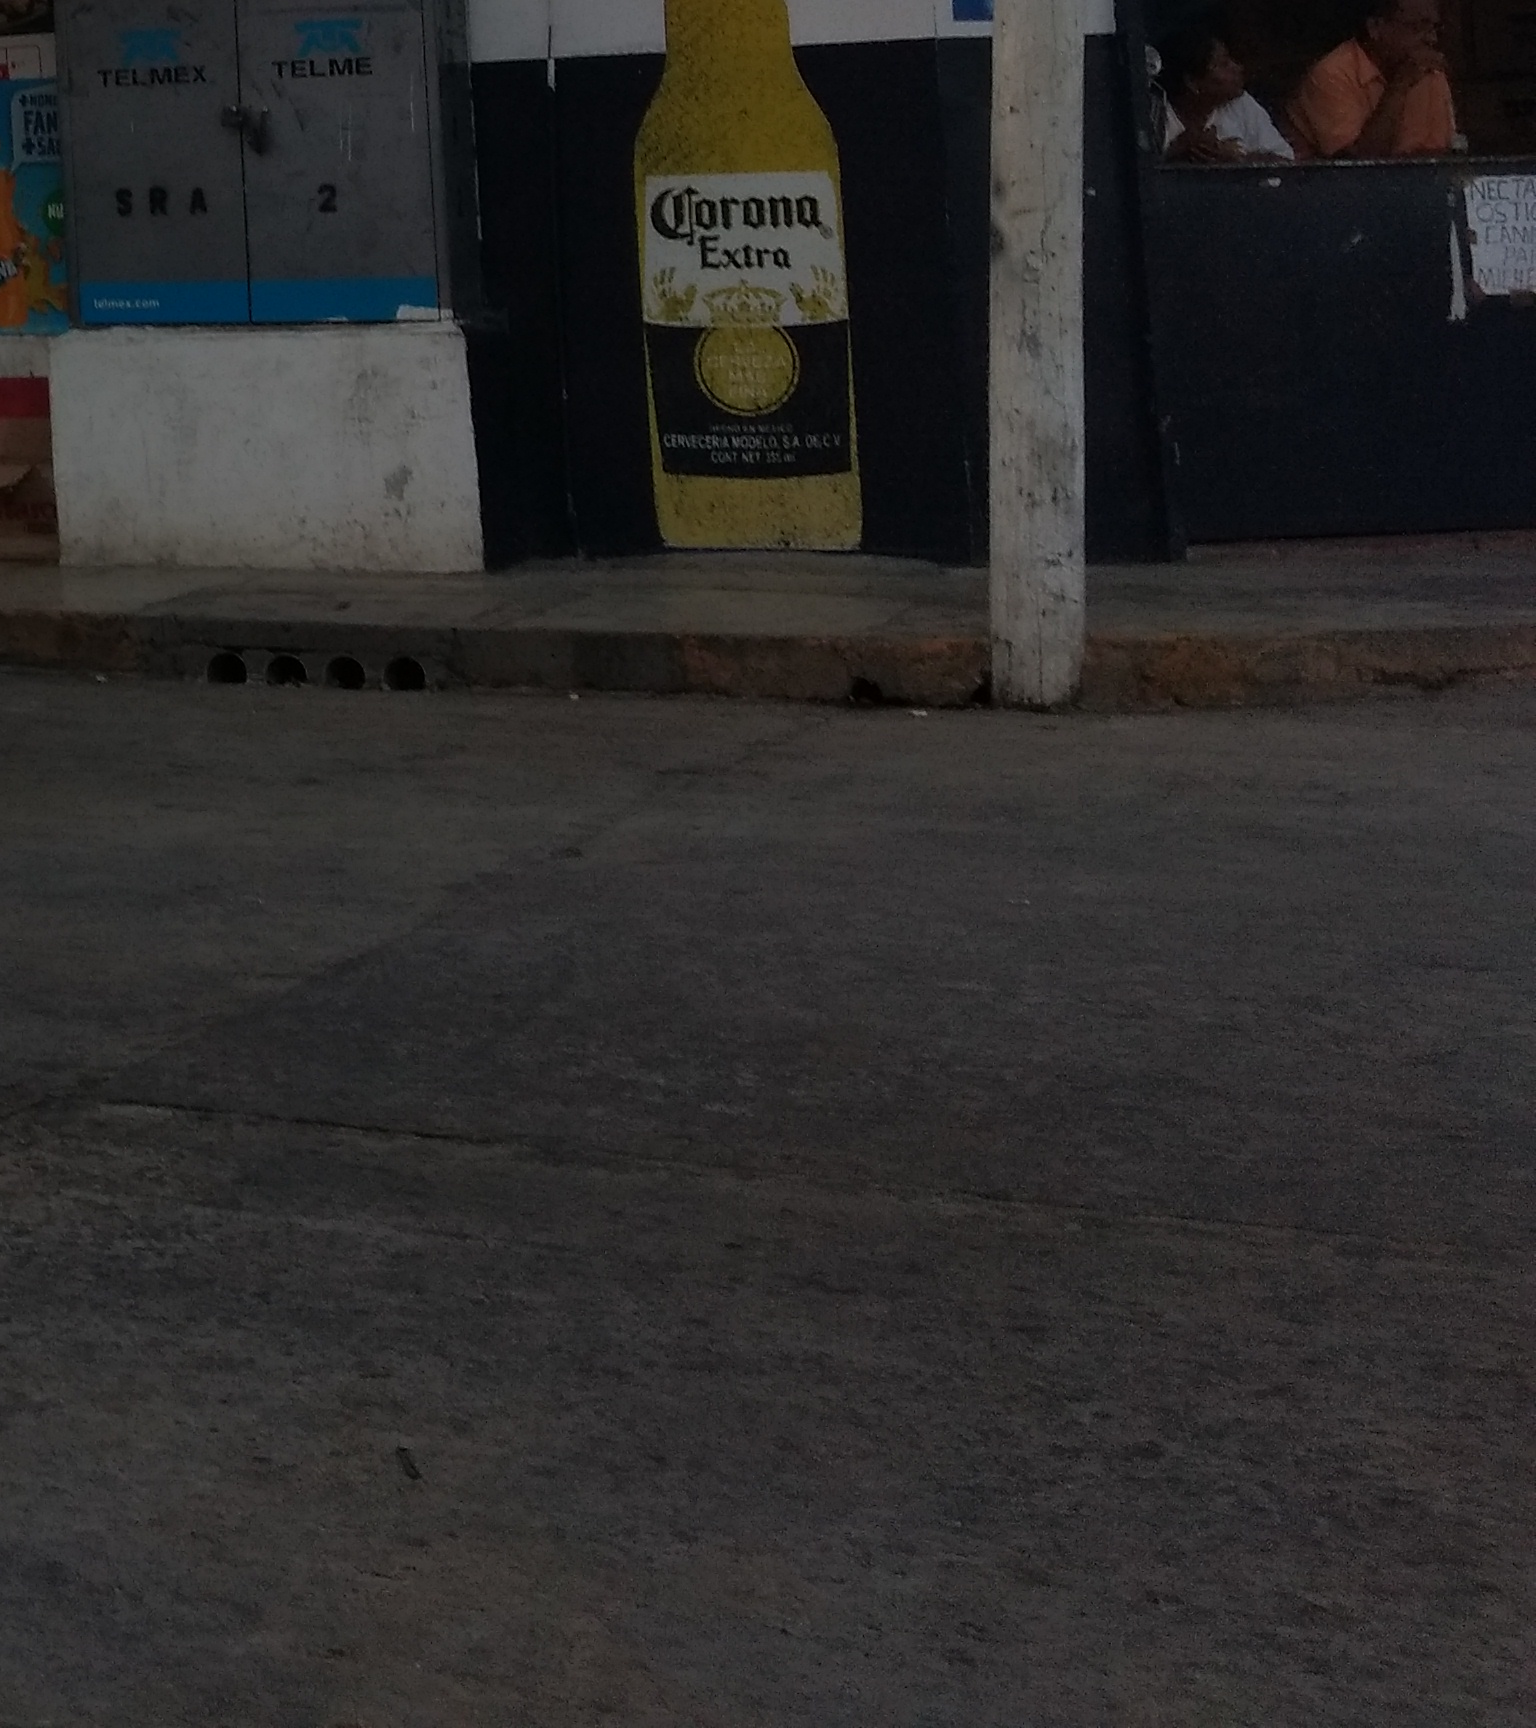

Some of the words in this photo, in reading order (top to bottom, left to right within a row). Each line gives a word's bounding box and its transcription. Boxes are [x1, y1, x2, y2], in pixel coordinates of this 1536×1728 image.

[97, 65, 207, 89] TELMEX
[271, 56, 373, 80] TELME
[317, 183, 338, 214] 2
[650, 185, 824, 246] Corona
[699, 233, 793, 271] Extra
